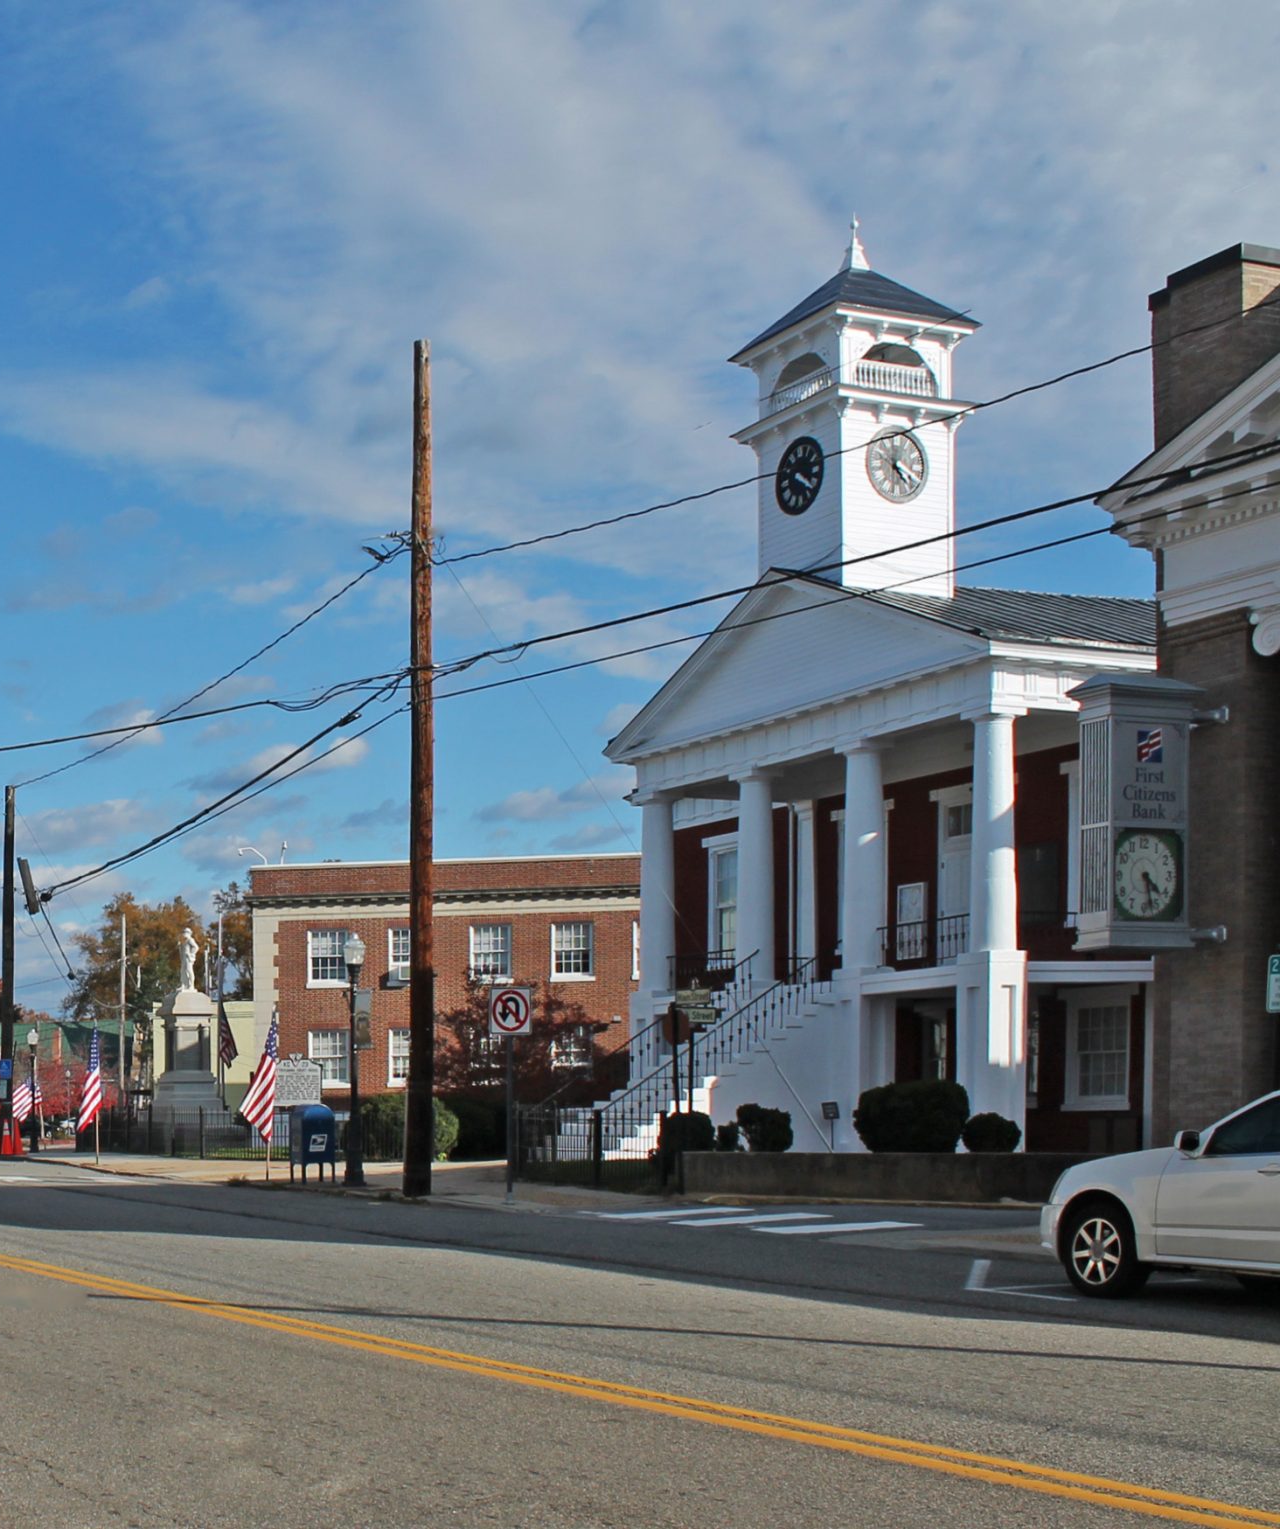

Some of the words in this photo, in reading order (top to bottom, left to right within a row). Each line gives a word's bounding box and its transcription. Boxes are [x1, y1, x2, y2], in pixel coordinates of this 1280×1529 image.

[1135, 767, 1164, 784] First
[1122, 784, 1177, 802] Citizens
[1131, 802, 1166, 820] Bank
[1139, 838, 1150, 849] 12
[1154, 843, 1159, 854] 1
[1119, 852, 1129, 864] 10
[1162, 854, 1169, 866] 2
[1166, 870, 1172, 882] 3
[1120, 886, 1126, 898] 8
[1163, 886, 1169, 898] 4
[1129, 897, 1135, 909] 7
[1272, 958, 1279, 972] 2
[691, 1010, 713, 1020] Street
